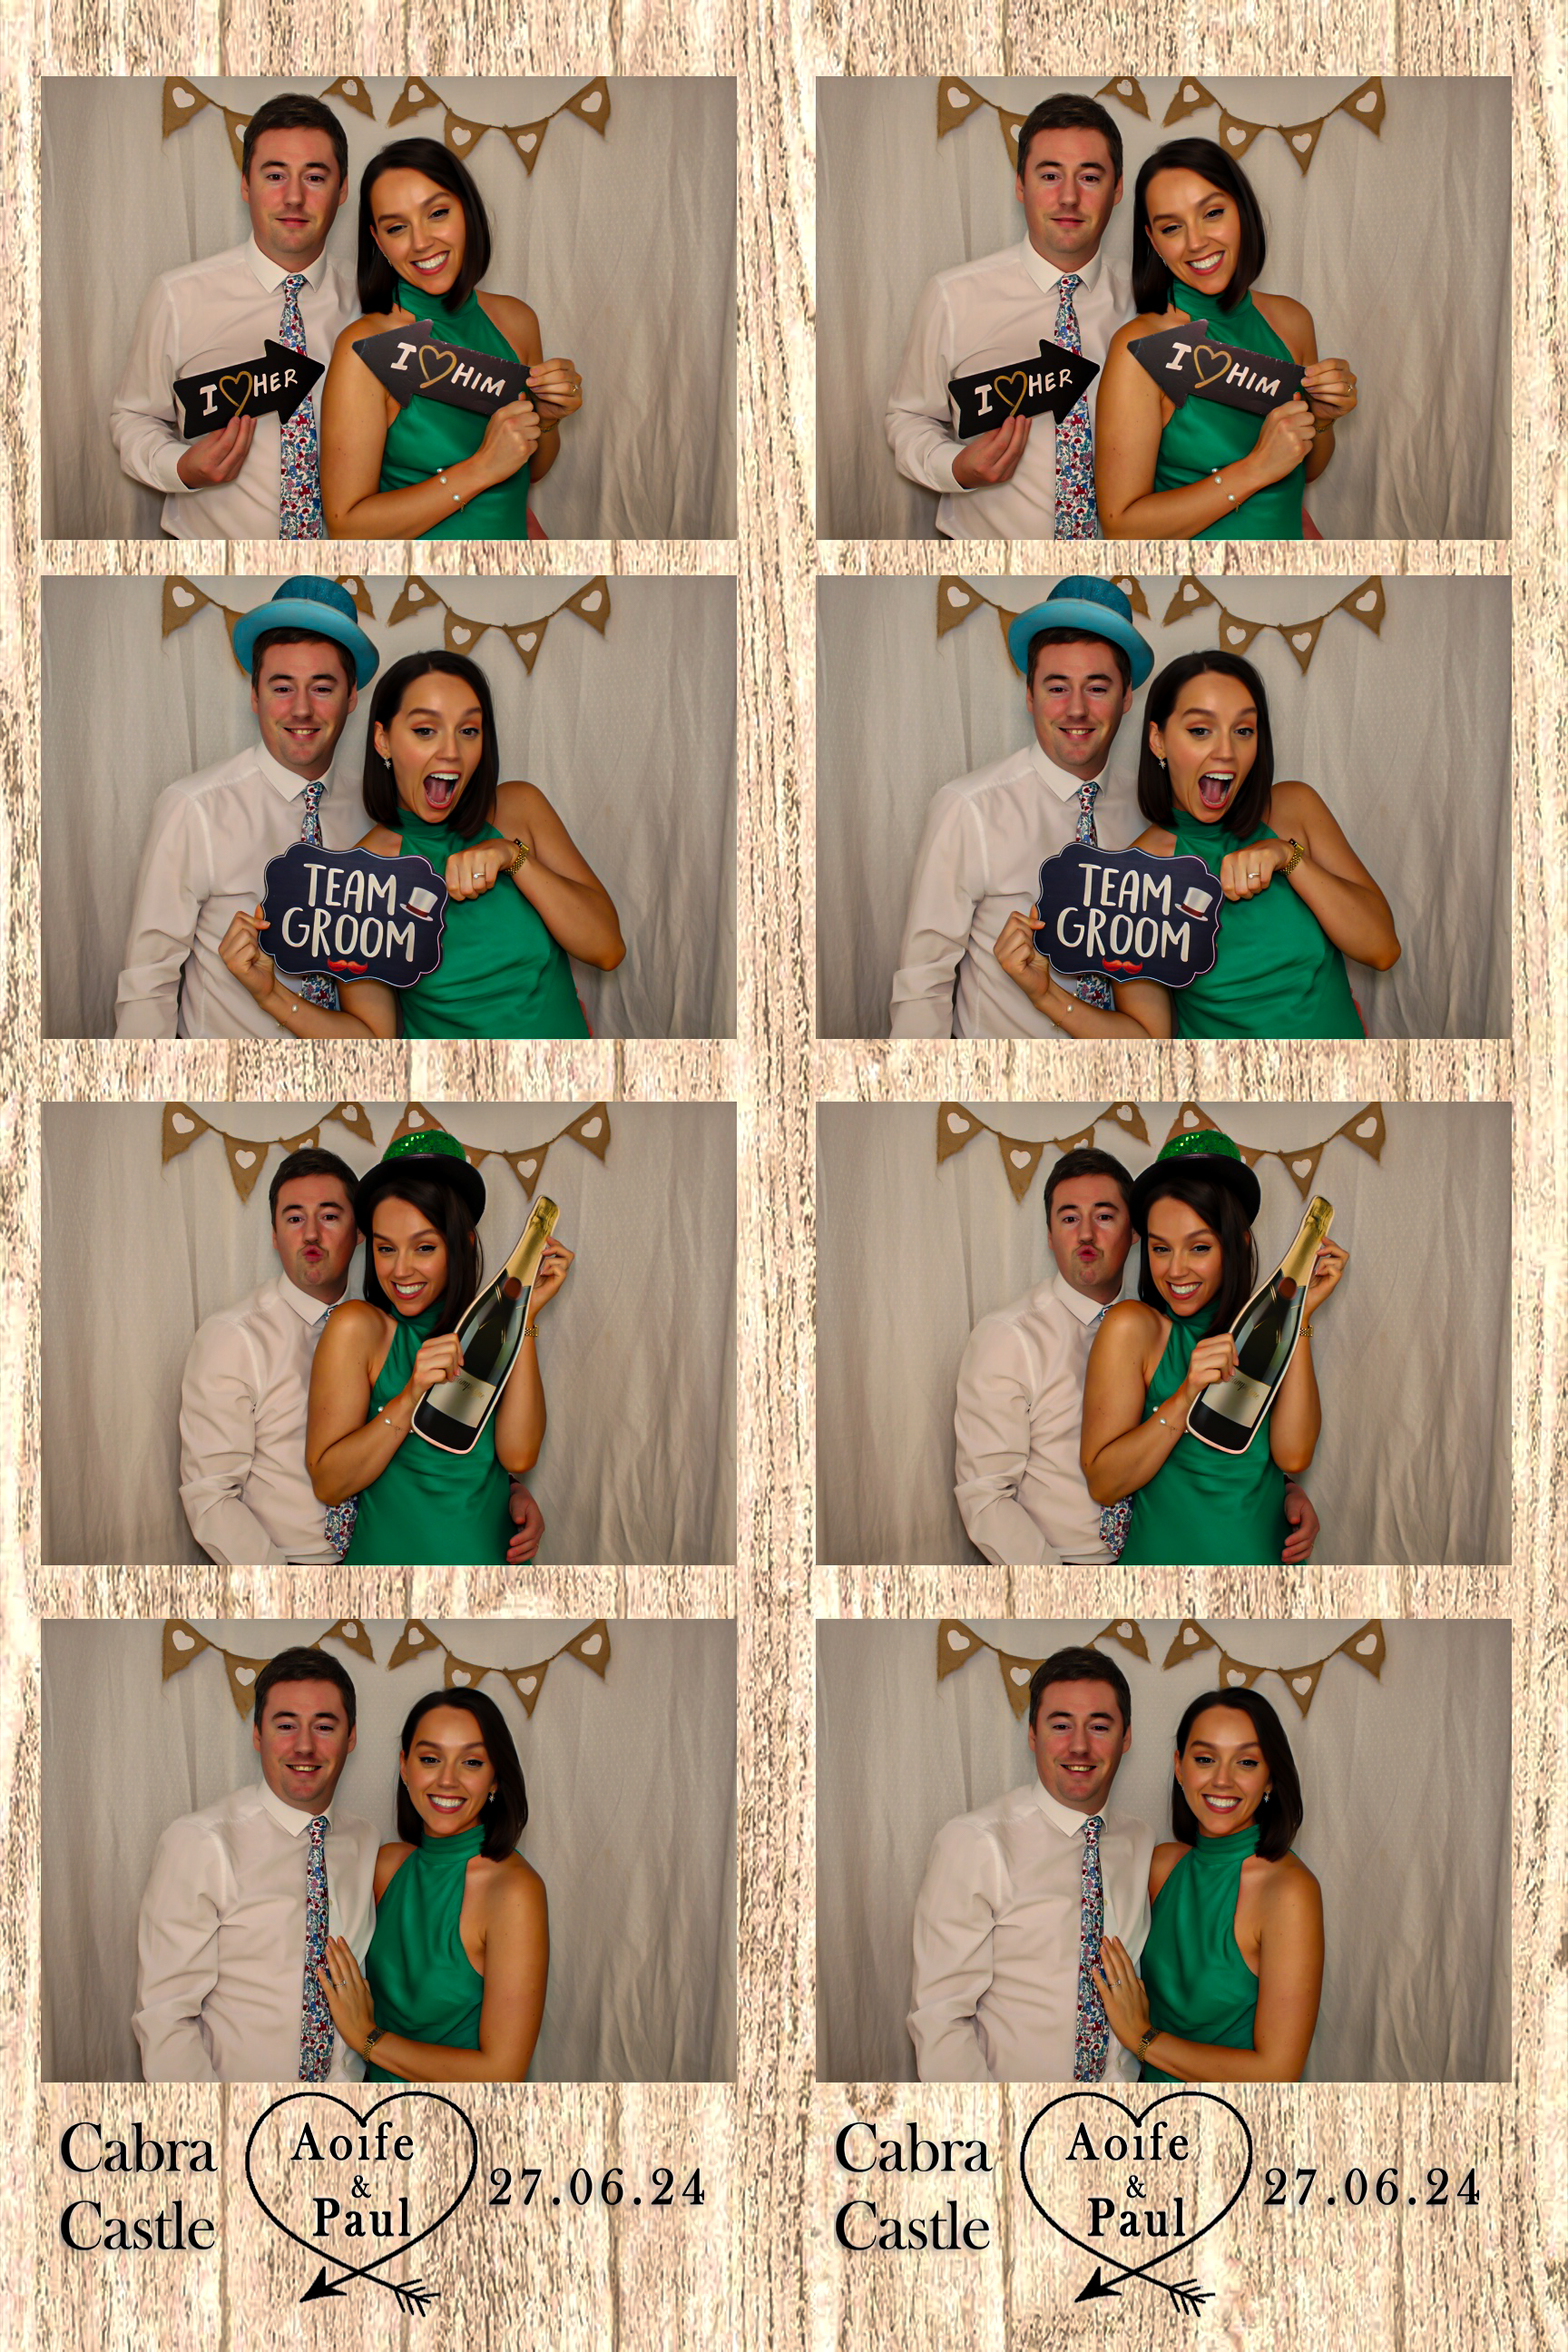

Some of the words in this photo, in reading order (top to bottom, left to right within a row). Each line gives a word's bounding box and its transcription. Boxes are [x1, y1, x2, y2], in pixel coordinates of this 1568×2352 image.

[201, 385, 218, 416] I
[253, 368, 298, 397] HER
[390, 341, 416, 371] I
[451, 363, 506, 397] HIM
[975, 385, 993, 416] I
[1028, 368, 1073, 397] HER
[1165, 341, 1191, 371] I
[1226, 363, 1281, 397] HIM
[303, 863, 397, 916] TEAM
[1078, 863, 1171, 916] TEAM
[281, 906, 416, 963] GROOM
[1056, 906, 1191, 963] GROOM
